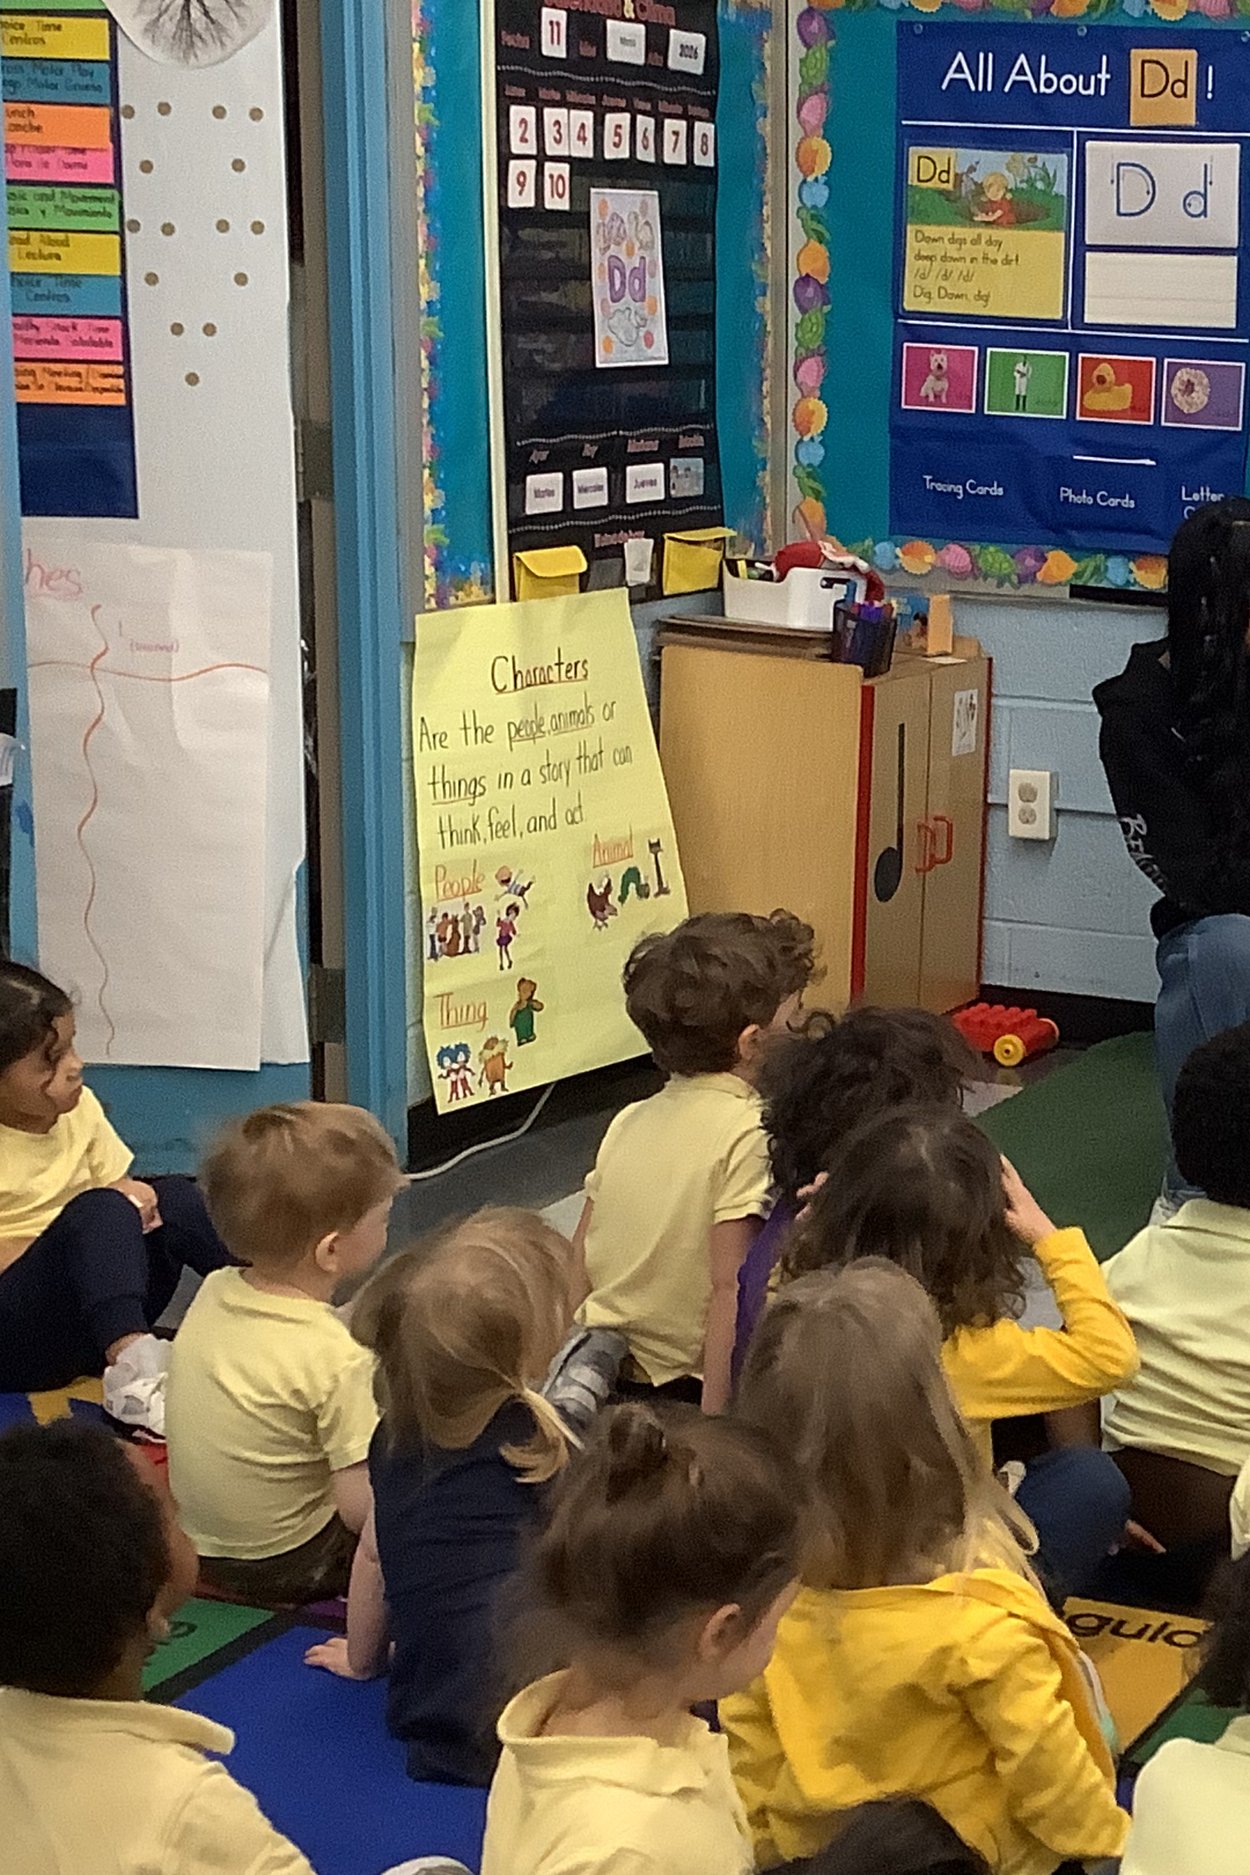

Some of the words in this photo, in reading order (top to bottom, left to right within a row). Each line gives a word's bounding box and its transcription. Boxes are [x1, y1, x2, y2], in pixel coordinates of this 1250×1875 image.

[549, 20, 562, 46] 11
[941, 51, 993, 92] All
[1003, 53, 1112, 96] About
[1140, 59, 1189, 99] Dd
[518, 117, 529, 144] 2
[552, 119, 563, 145] 3
[577, 122, 587, 146] 4
[613, 124, 623, 148] 5
[641, 127, 649, 151] 6
[671, 131, 680, 153] 7
[700, 133, 709, 156] 8
[516, 170, 527, 196] 9
[549, 173, 566, 199] 10
[916, 155, 951, 184] Dd
[1115, 162, 1156, 217] D
[1183, 163, 1208, 218] d
[607, 255, 647, 303] Dd
[923, 474, 963, 499] Tracing
[966, 479, 1004, 497] Cards
[1060, 486, 1094, 506] Photo
[1097, 490, 1136, 509] Cards
[1181, 486, 1225, 503] Letter
[25, 548, 83, 598] hes
[491, 647, 588, 694] Characters
[419, 716, 449, 752] Are
[462, 709, 495, 747] the
[602, 700, 617, 721] or
[427, 764, 487, 806] things
[498, 771, 513, 790] in
[521, 771, 531, 787] a
[539, 749, 571, 787] story
[576, 736, 605, 775] that
[613, 744, 633, 767] can
[526, 797, 557, 834] and
[565, 790, 583, 826] act
[434, 859, 485, 902] People
[434, 992, 488, 1032] Thing
